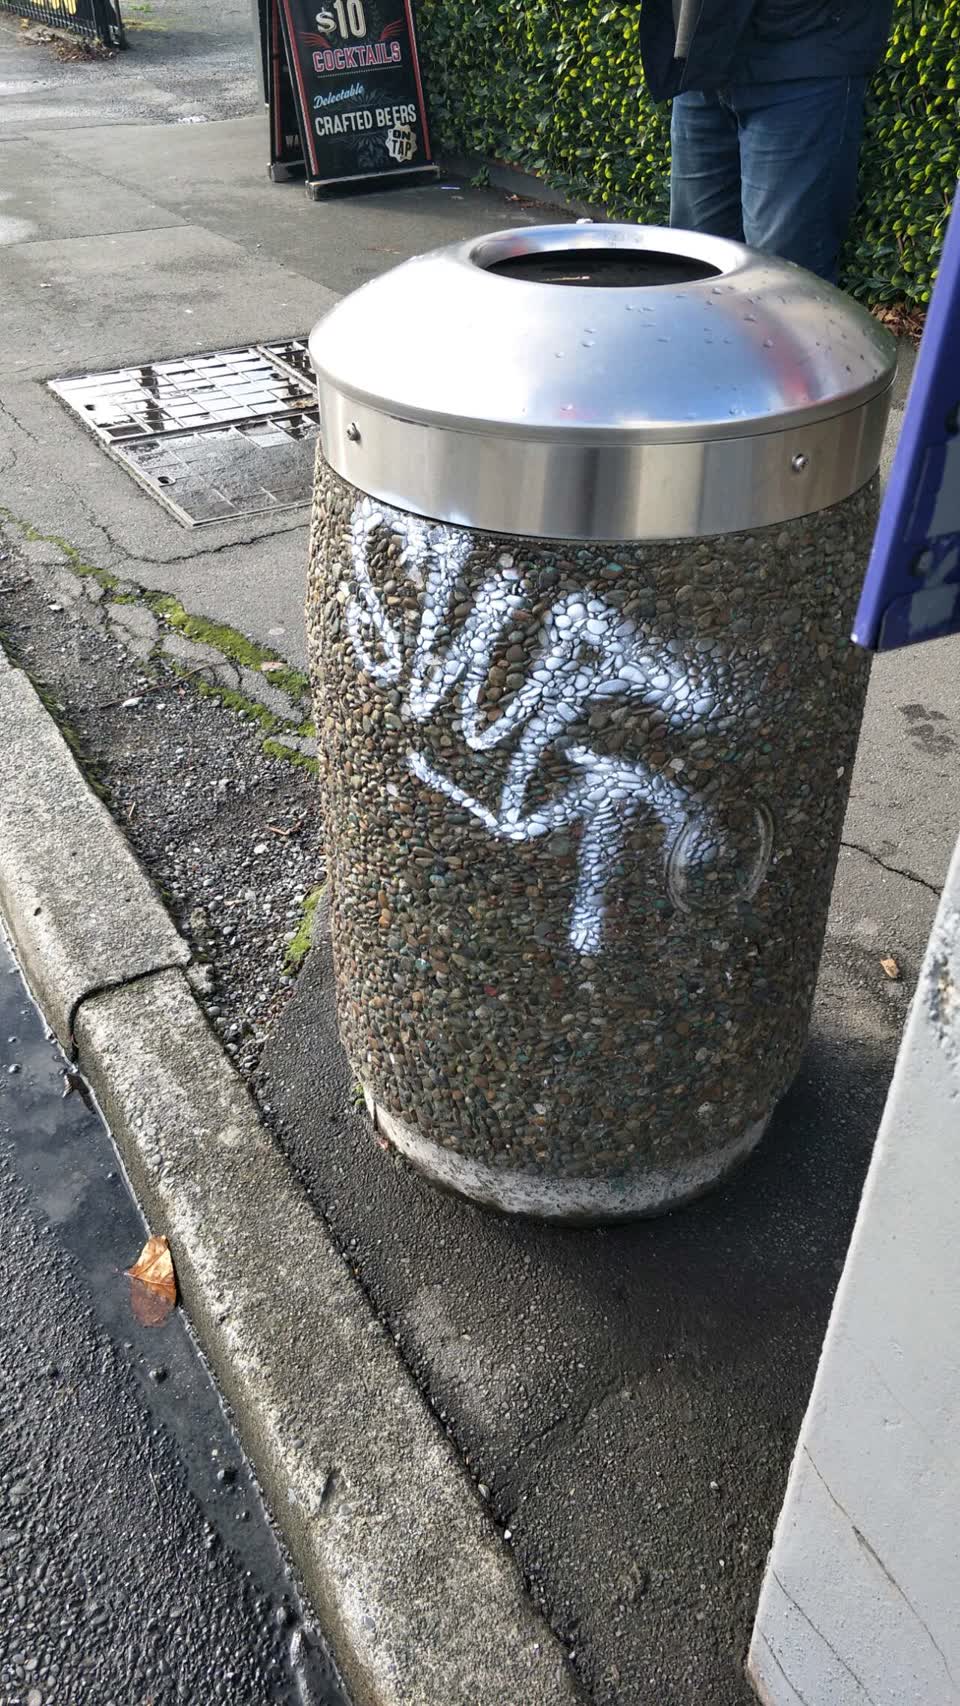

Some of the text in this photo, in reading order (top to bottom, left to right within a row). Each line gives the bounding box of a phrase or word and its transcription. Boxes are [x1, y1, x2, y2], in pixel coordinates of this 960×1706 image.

[315, 0, 367, 39] $10
[312, 41, 402, 73] COCKTAILS
[313, 82, 365, 109] Delectable
[314, 104, 417, 136] CRAFTED BEERS
[392, 129, 411, 140] ON
[392, 139, 412, 157] TAP
